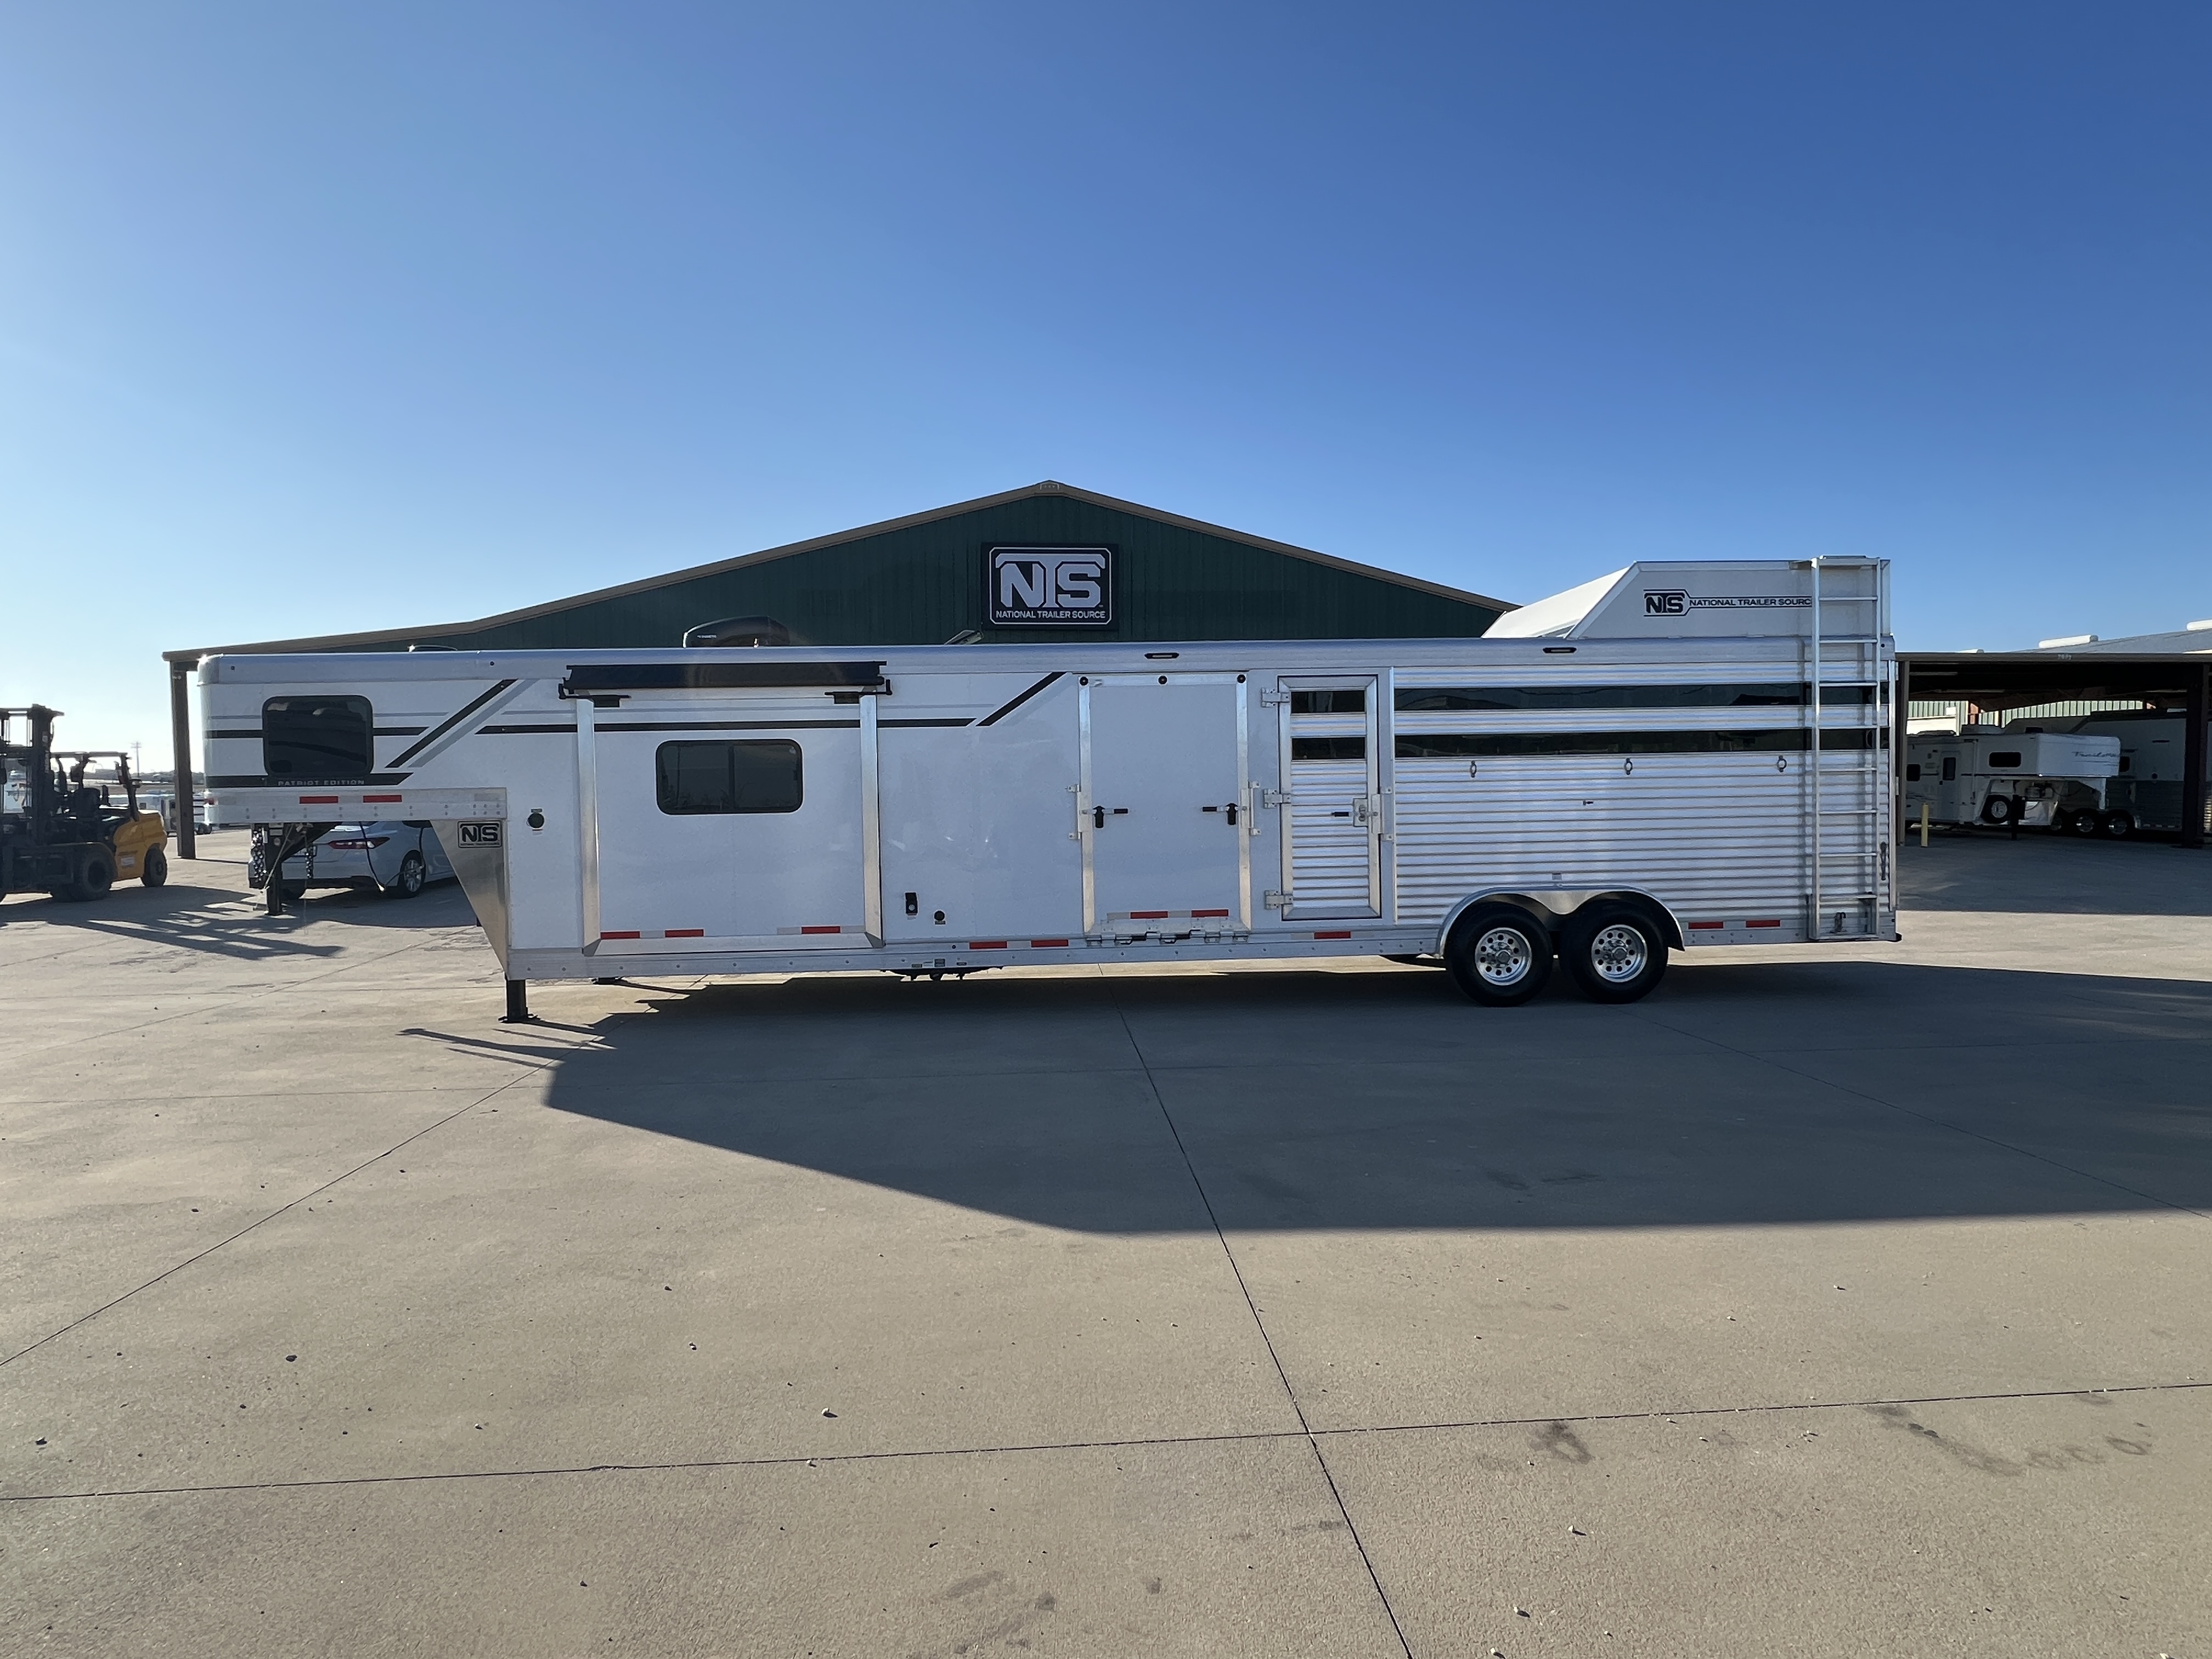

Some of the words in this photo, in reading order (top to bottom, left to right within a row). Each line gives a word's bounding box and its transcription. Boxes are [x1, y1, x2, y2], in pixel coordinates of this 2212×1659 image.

[995, 553, 1106, 608] NTS
[1644, 592, 1685, 613] NTS
[995, 610, 1036, 618] NATIONAL
[1037, 610, 1071, 618] TRAILER
[1071, 610, 1106, 618] SOURCE
[460, 823, 499, 842] NTS
